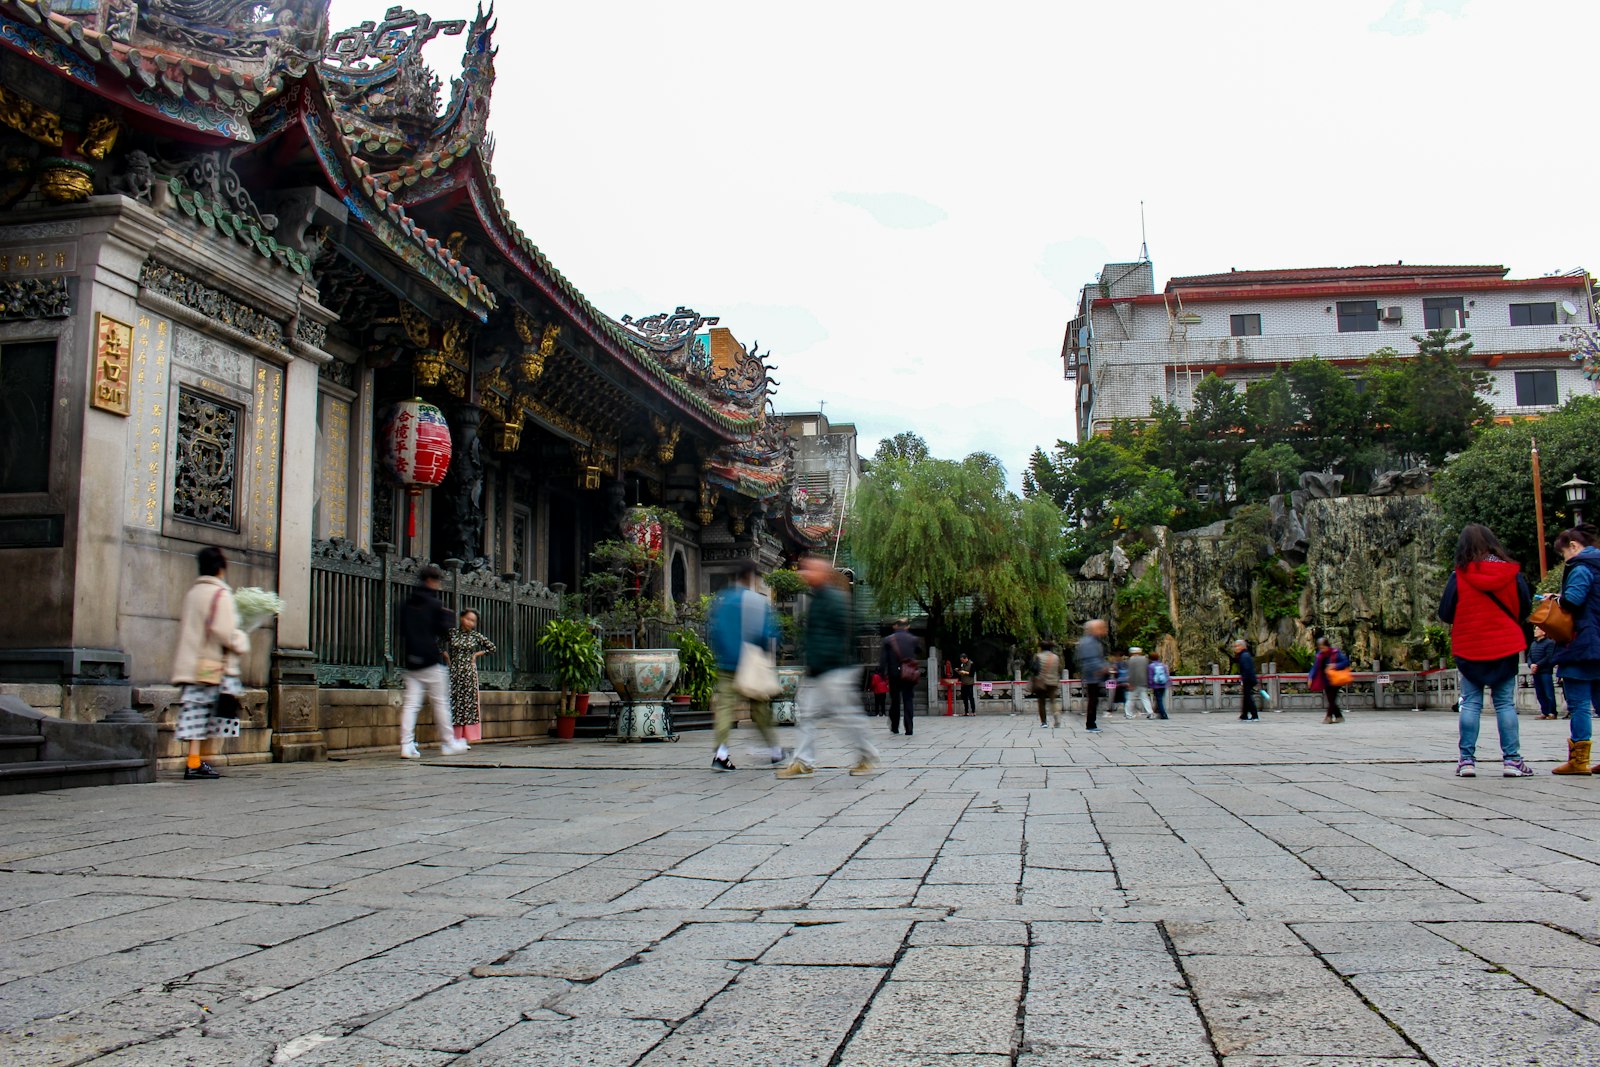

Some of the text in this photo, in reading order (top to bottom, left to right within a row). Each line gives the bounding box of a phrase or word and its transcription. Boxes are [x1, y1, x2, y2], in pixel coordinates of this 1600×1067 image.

[103, 329, 122, 382] 出口
[98, 384, 125, 404] EXIT
[394, 410, 414, 473] 合境平安
